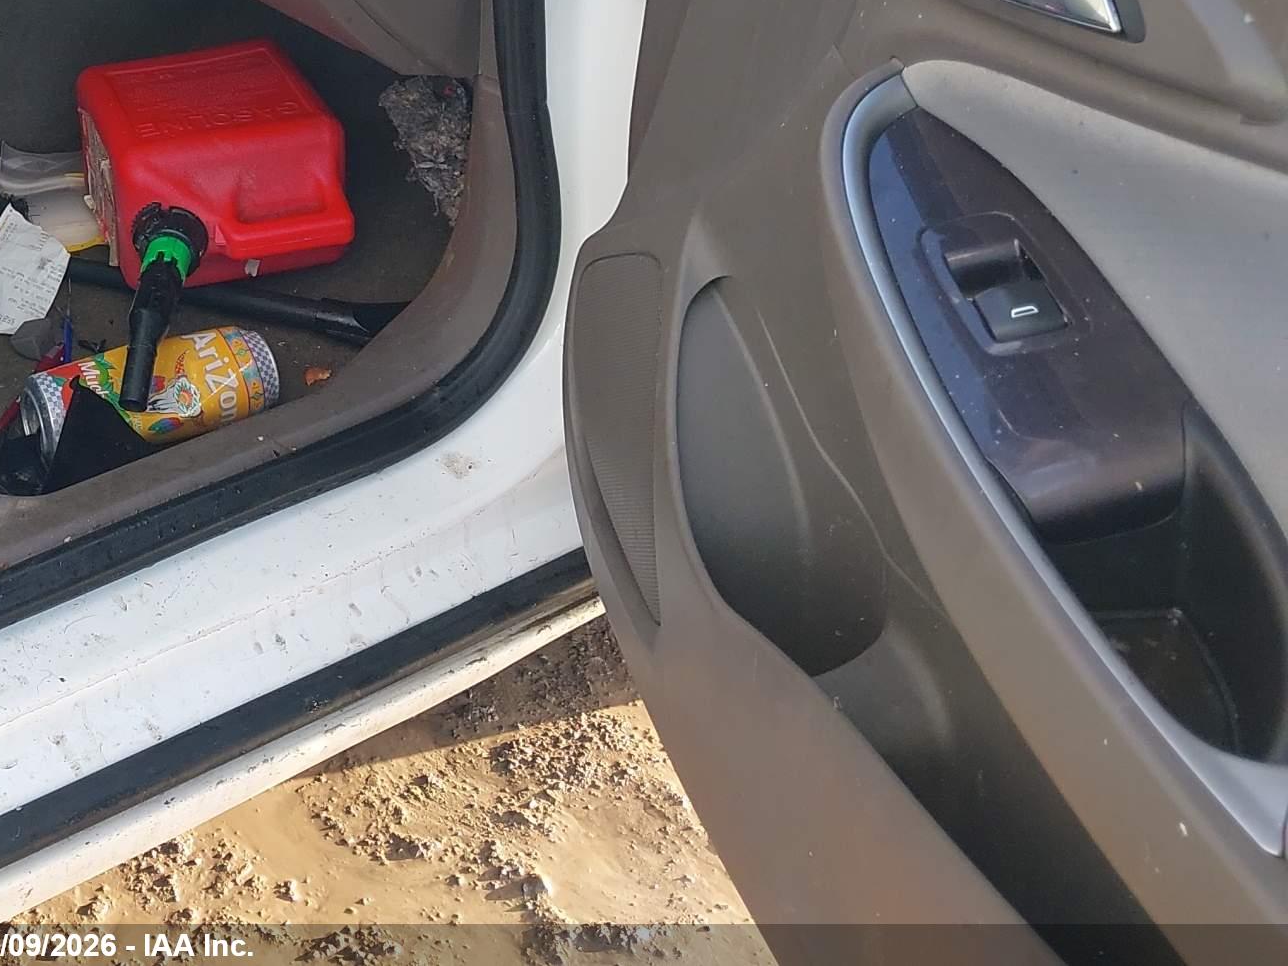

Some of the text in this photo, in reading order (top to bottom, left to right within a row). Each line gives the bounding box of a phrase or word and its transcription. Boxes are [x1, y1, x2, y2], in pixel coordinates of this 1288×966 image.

[136, 101, 298, 138] GASOLINE
[78, 360, 110, 400] Much
[182, 332, 239, 422] AriZon
